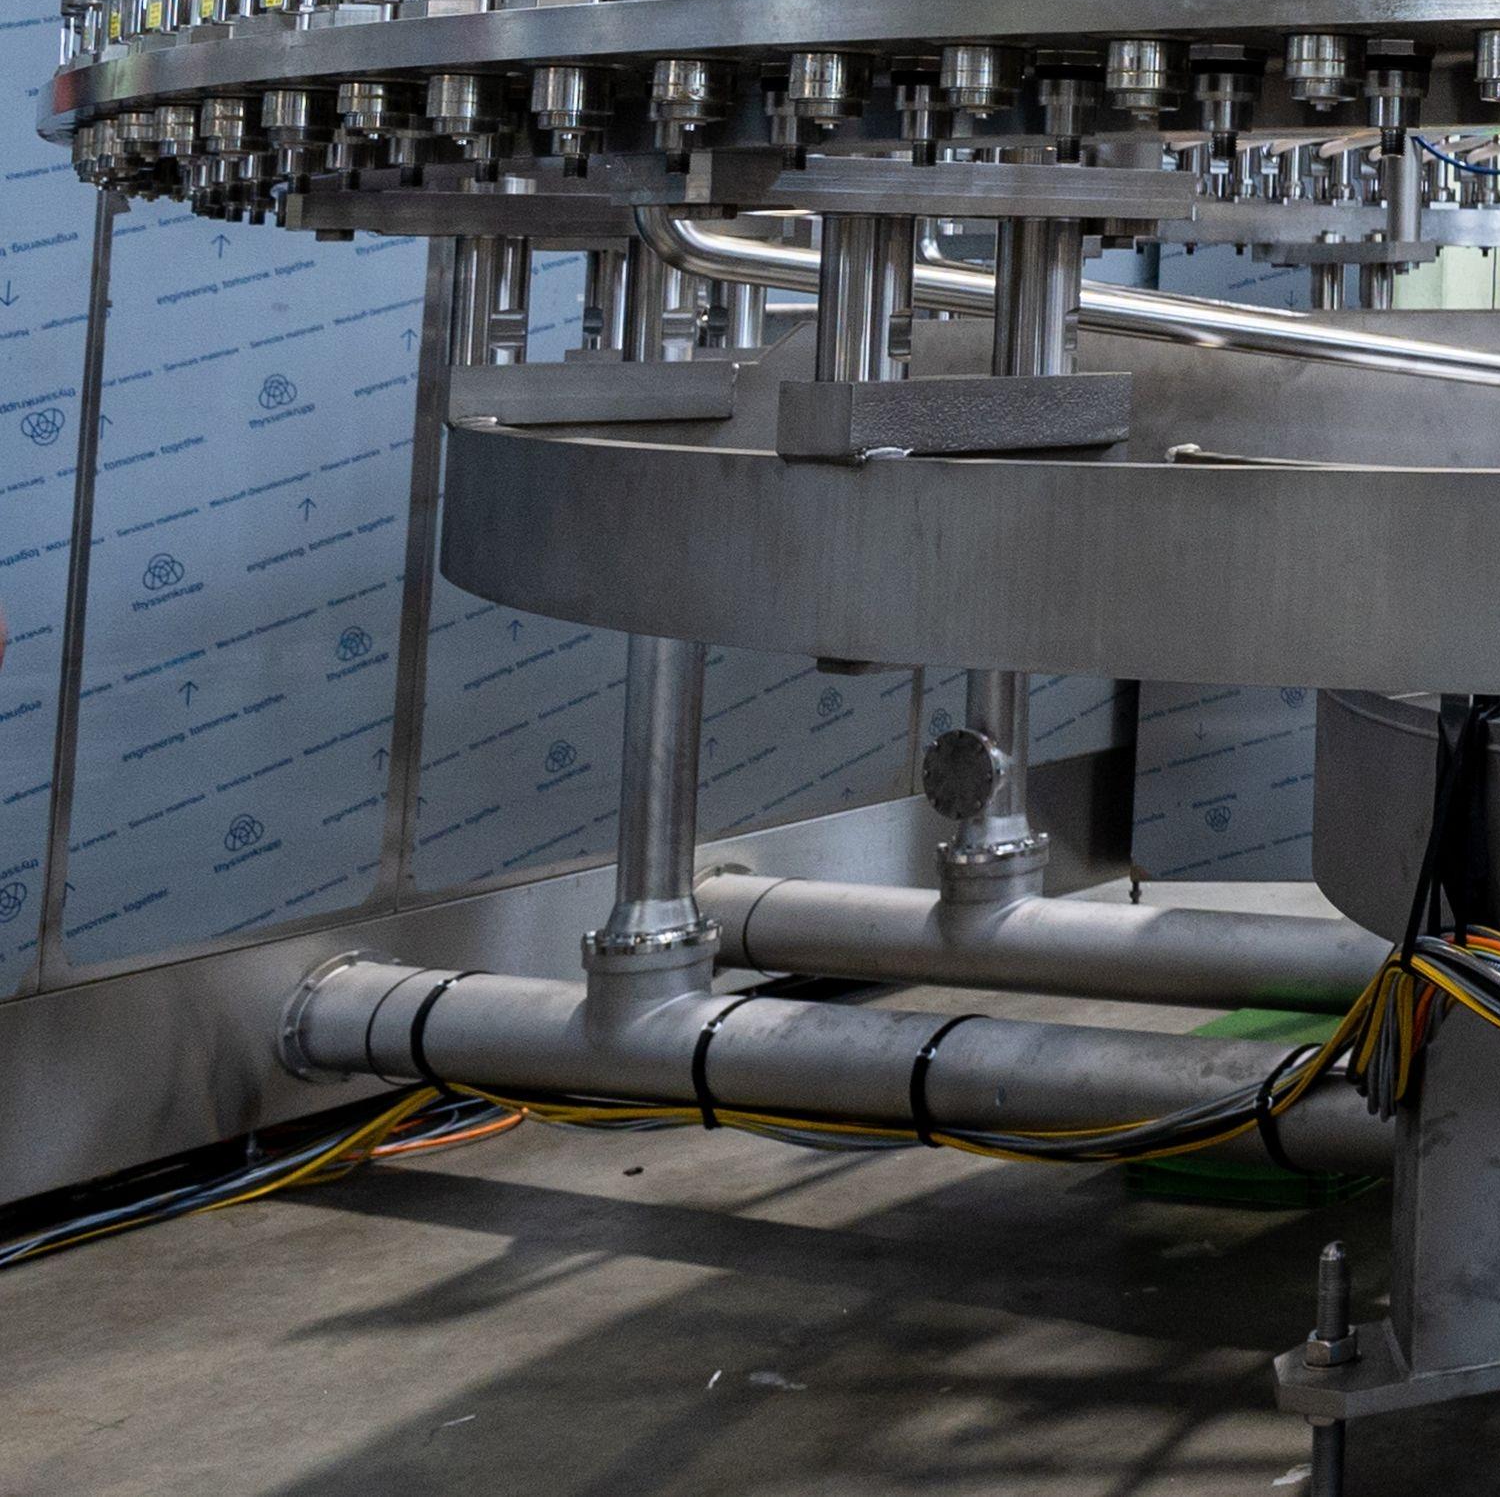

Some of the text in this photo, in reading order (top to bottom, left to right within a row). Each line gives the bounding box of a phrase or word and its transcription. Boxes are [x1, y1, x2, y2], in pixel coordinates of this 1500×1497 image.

[157, 282, 218, 305] engineering.
[222, 271, 270, 288] tomorrow.
[249, 403, 315, 429] thyssenkrupp
[104, 451, 158, 471] tomorrow.
[132, 581, 205, 612] thyssenkrupp
